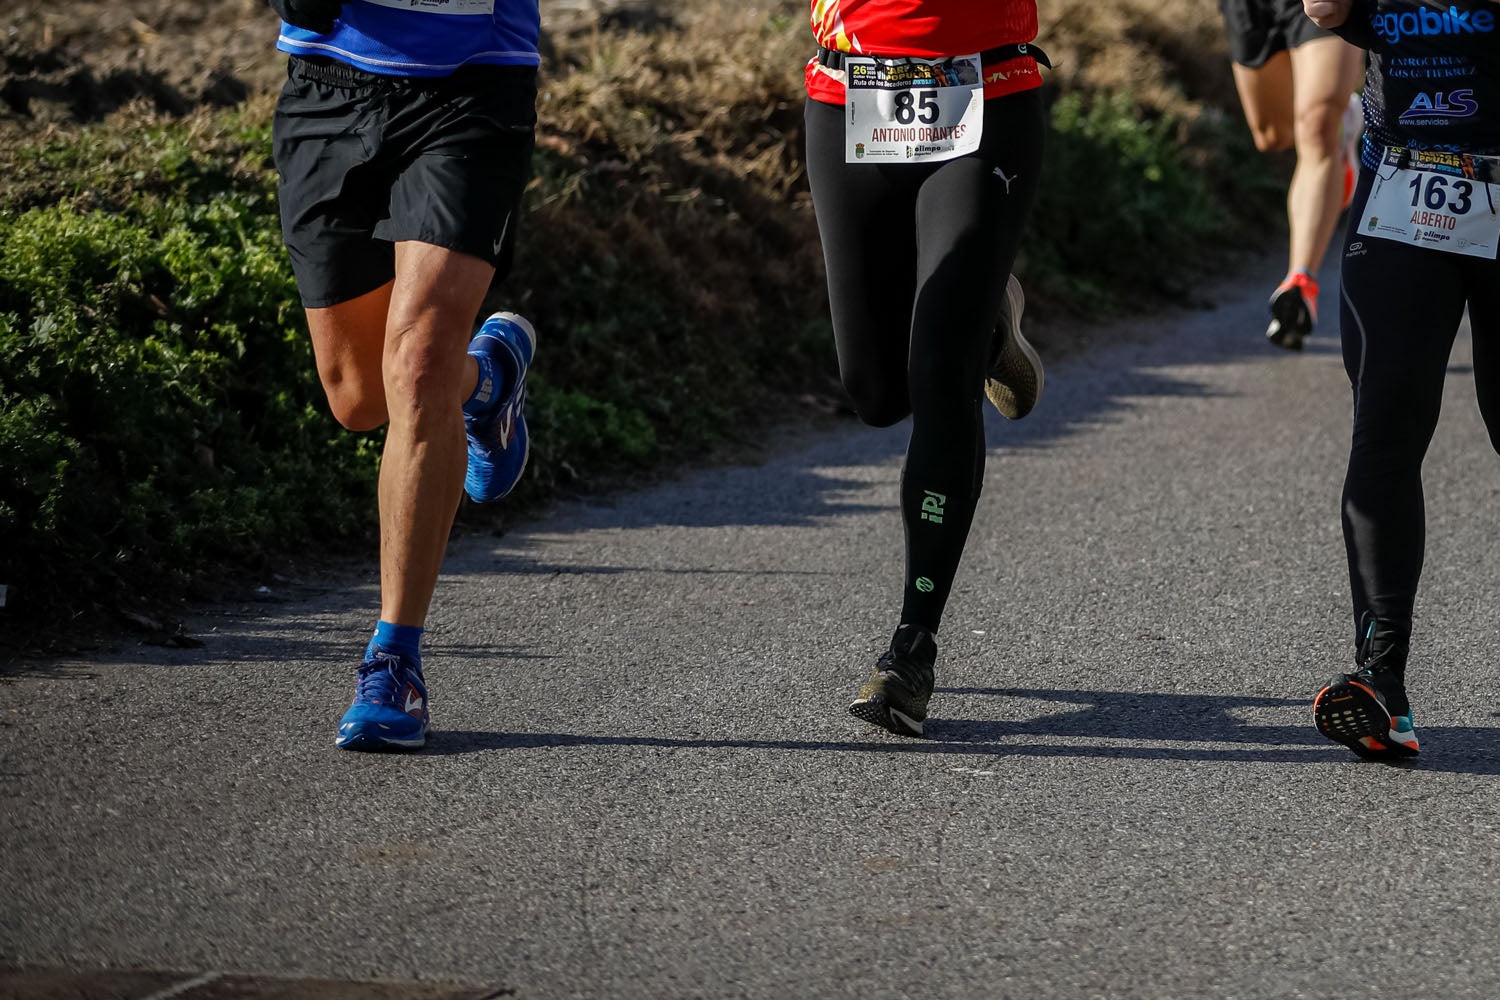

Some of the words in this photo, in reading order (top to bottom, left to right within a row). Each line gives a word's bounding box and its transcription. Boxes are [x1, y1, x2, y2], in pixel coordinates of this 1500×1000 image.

[1372, 6, 1495, 44] egabike
[853, 65, 867, 75] 26
[886, 71, 932, 80] POPULAR
[894, 90, 940, 125] 85
[1405, 89, 1479, 117] ALS
[872, 127, 916, 142] ANTONIO
[918, 124, 967, 142] ORANTES
[1409, 173, 1473, 215] 163
[1410, 210, 1456, 230] ALBERTO
[1423, 230, 1450, 241] olimpo
